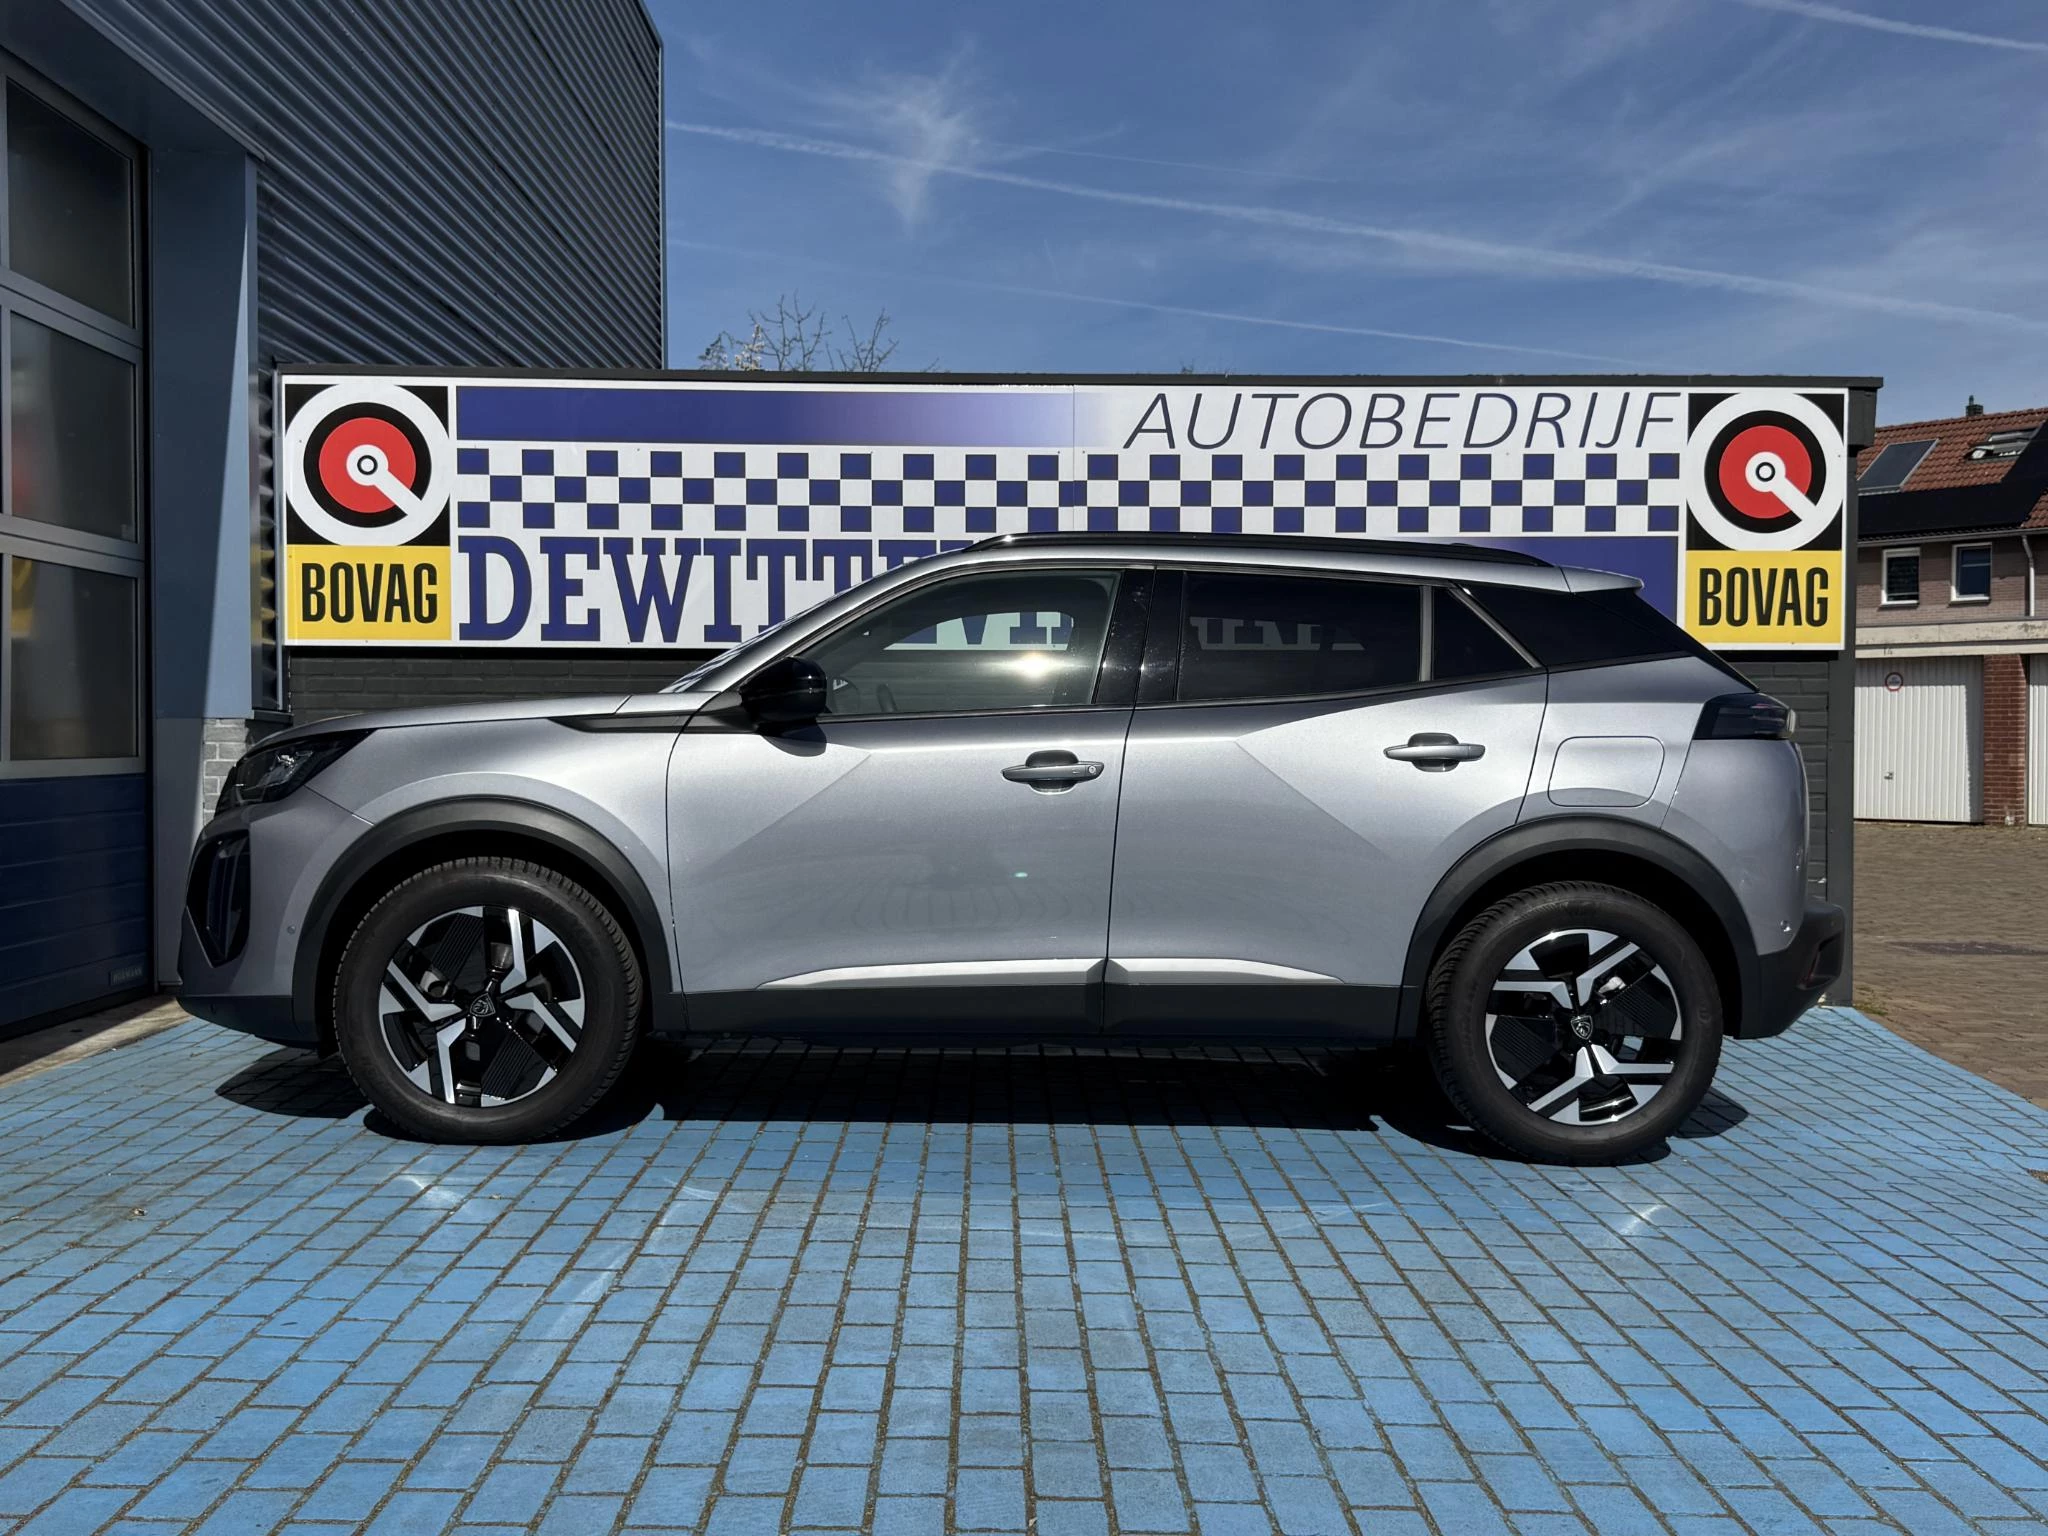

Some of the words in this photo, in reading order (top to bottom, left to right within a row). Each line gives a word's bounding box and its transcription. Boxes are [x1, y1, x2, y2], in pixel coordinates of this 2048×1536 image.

[1122, 392, 1682, 449] AUTOBEDRIJF
[301, 561, 438, 624] BOVAG
[1698, 566, 1829, 628] BOVAG
